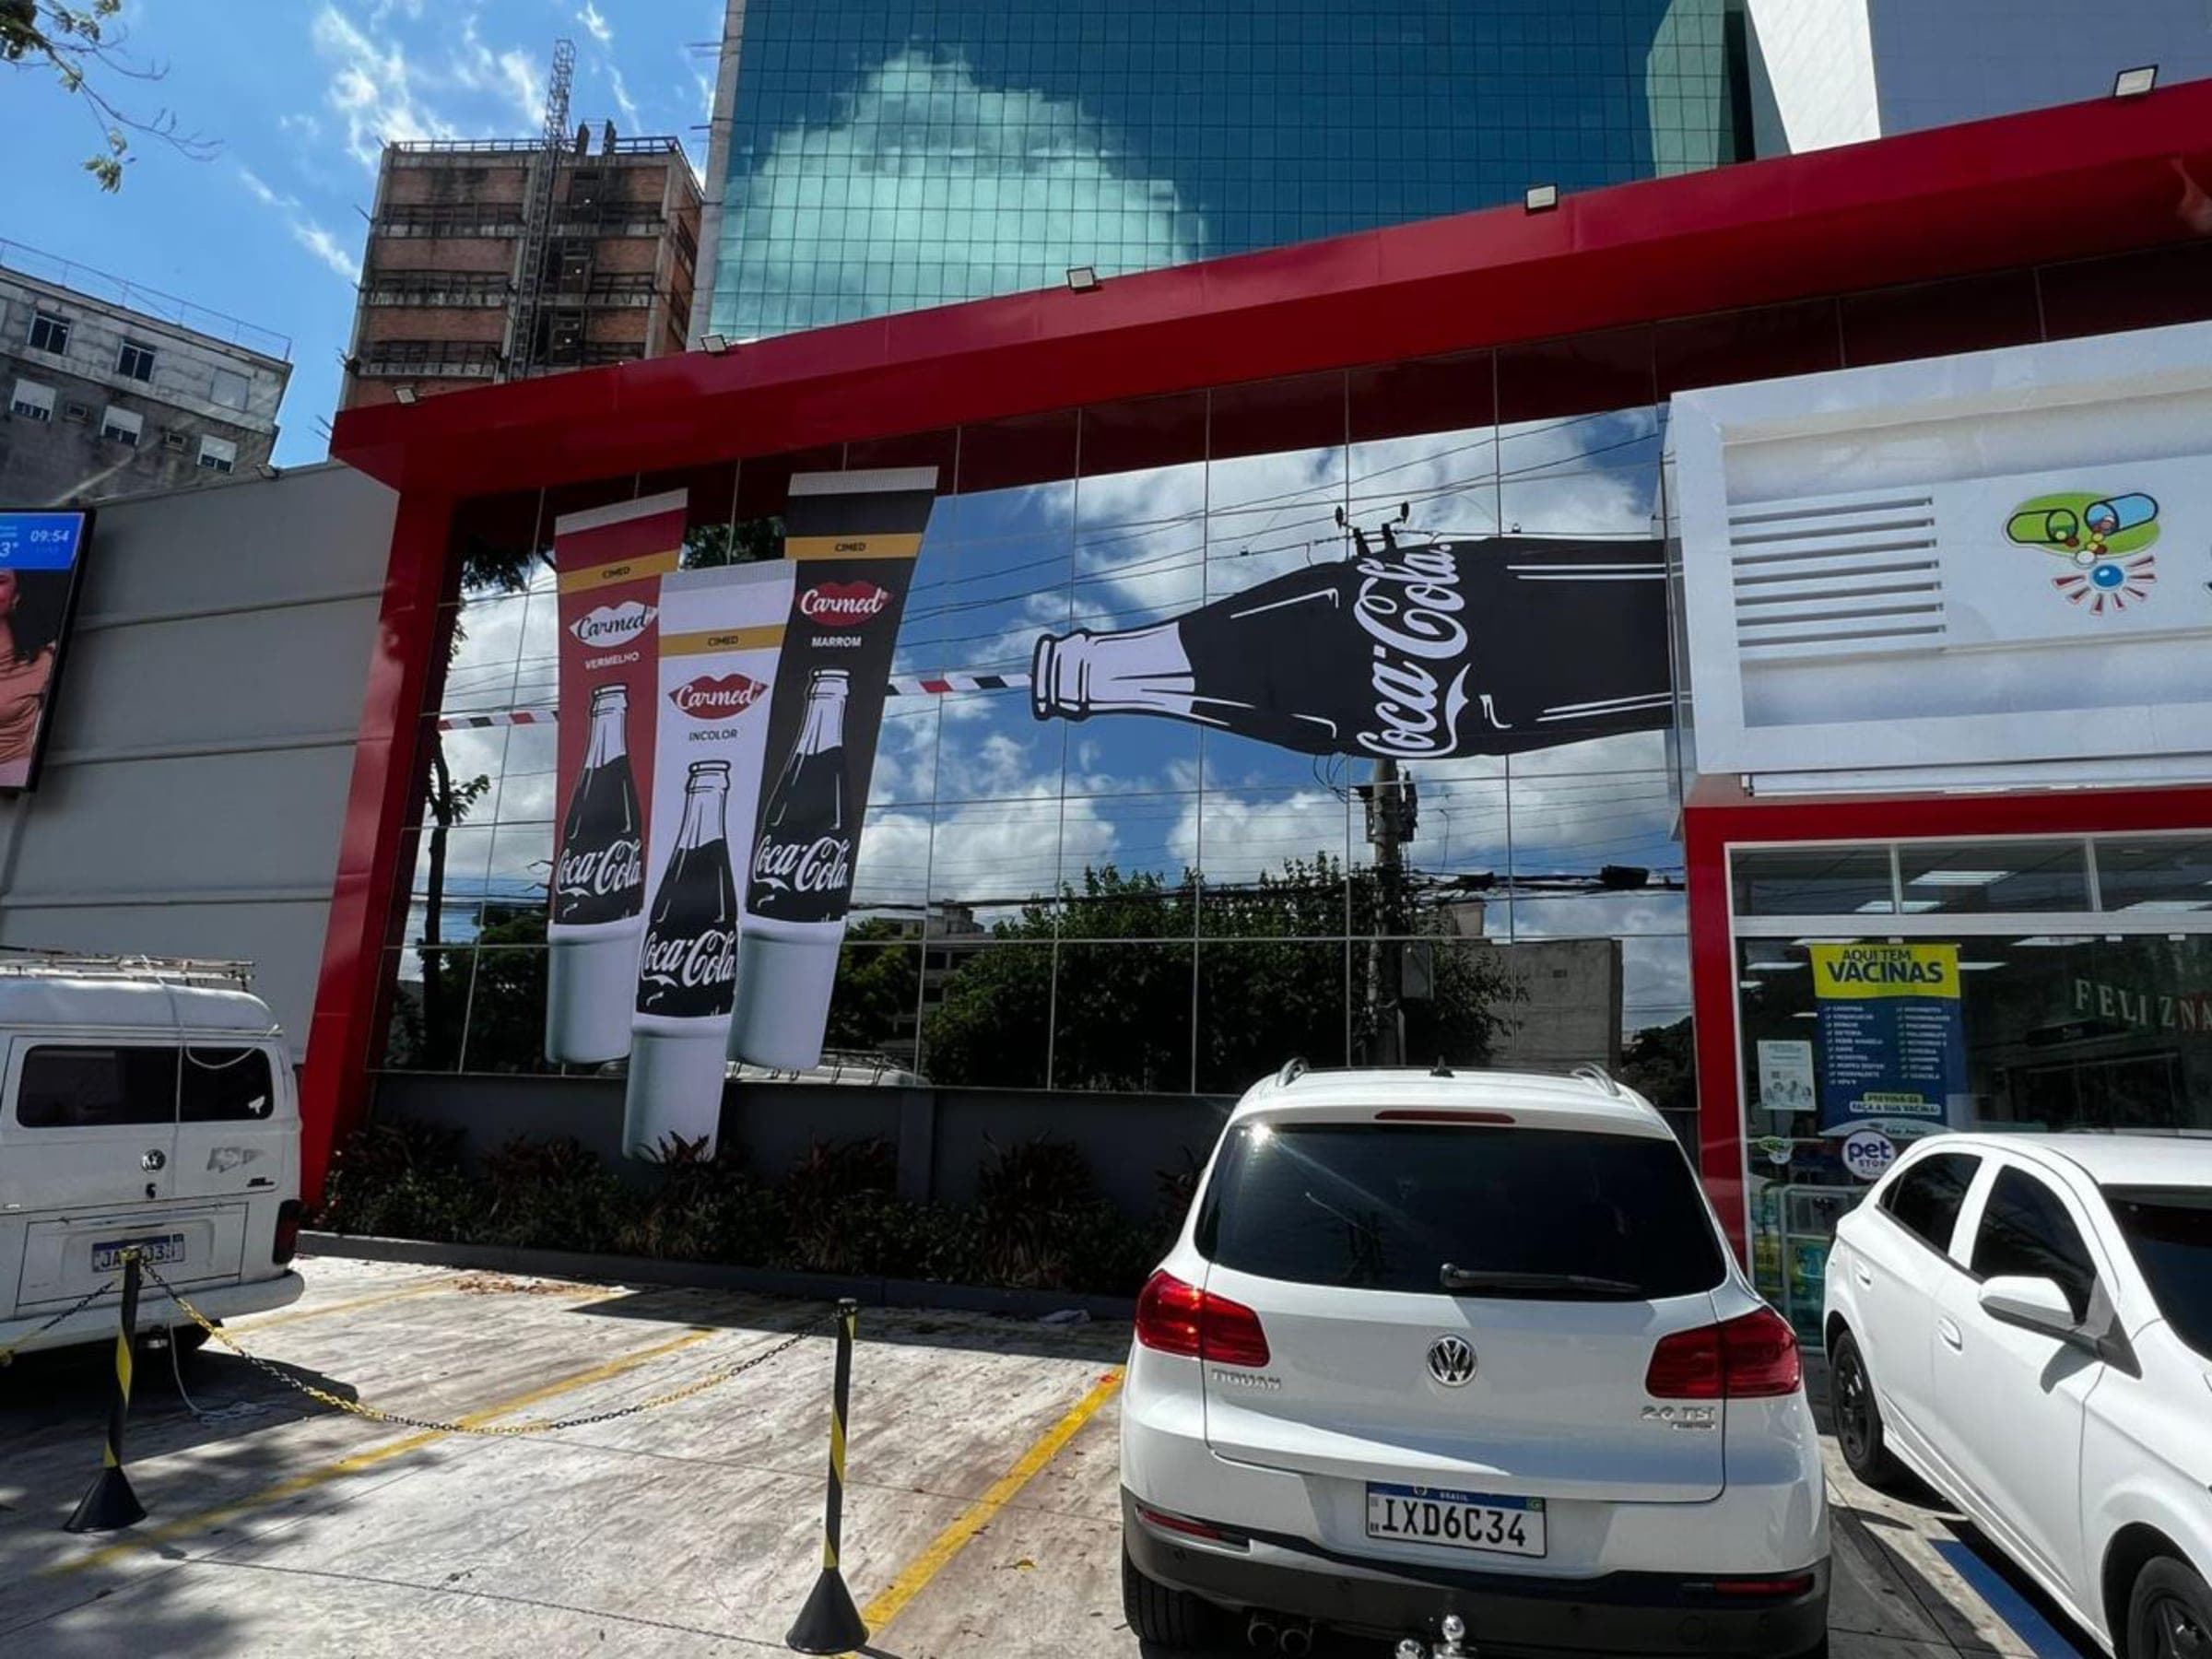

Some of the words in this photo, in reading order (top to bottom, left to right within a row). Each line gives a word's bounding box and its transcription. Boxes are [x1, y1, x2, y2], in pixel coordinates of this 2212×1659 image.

[30, 529, 70, 542] 09:54
[834, 542, 866, 552] CIMED
[602, 566, 630, 579] CIMED
[707, 636, 739, 646] CIMED
[811, 636, 862, 647] MARROM
[1354, 543, 1471, 759] Coca-Cola
[584, 652, 641, 669] VERMELHO
[688, 729, 738, 741] INCOLOR
[556, 838, 642, 897] Coca-Cola
[753, 834, 851, 892] Coca-Cola
[641, 929, 736, 988] Coca-Cola
[1842, 949, 1878, 961] AQUI
[1881, 950, 1912, 960] TEM
[1826, 961, 1944, 983] VACINAS
[2075, 978, 2176, 1027] FELIZ
[1847, 1141, 1891, 1161] pet
[1211, 1368, 1282, 1391] TIGUAN
[1682, 1406, 1715, 1420] TSI
[1382, 1498, 1526, 1547] IXD6C34
